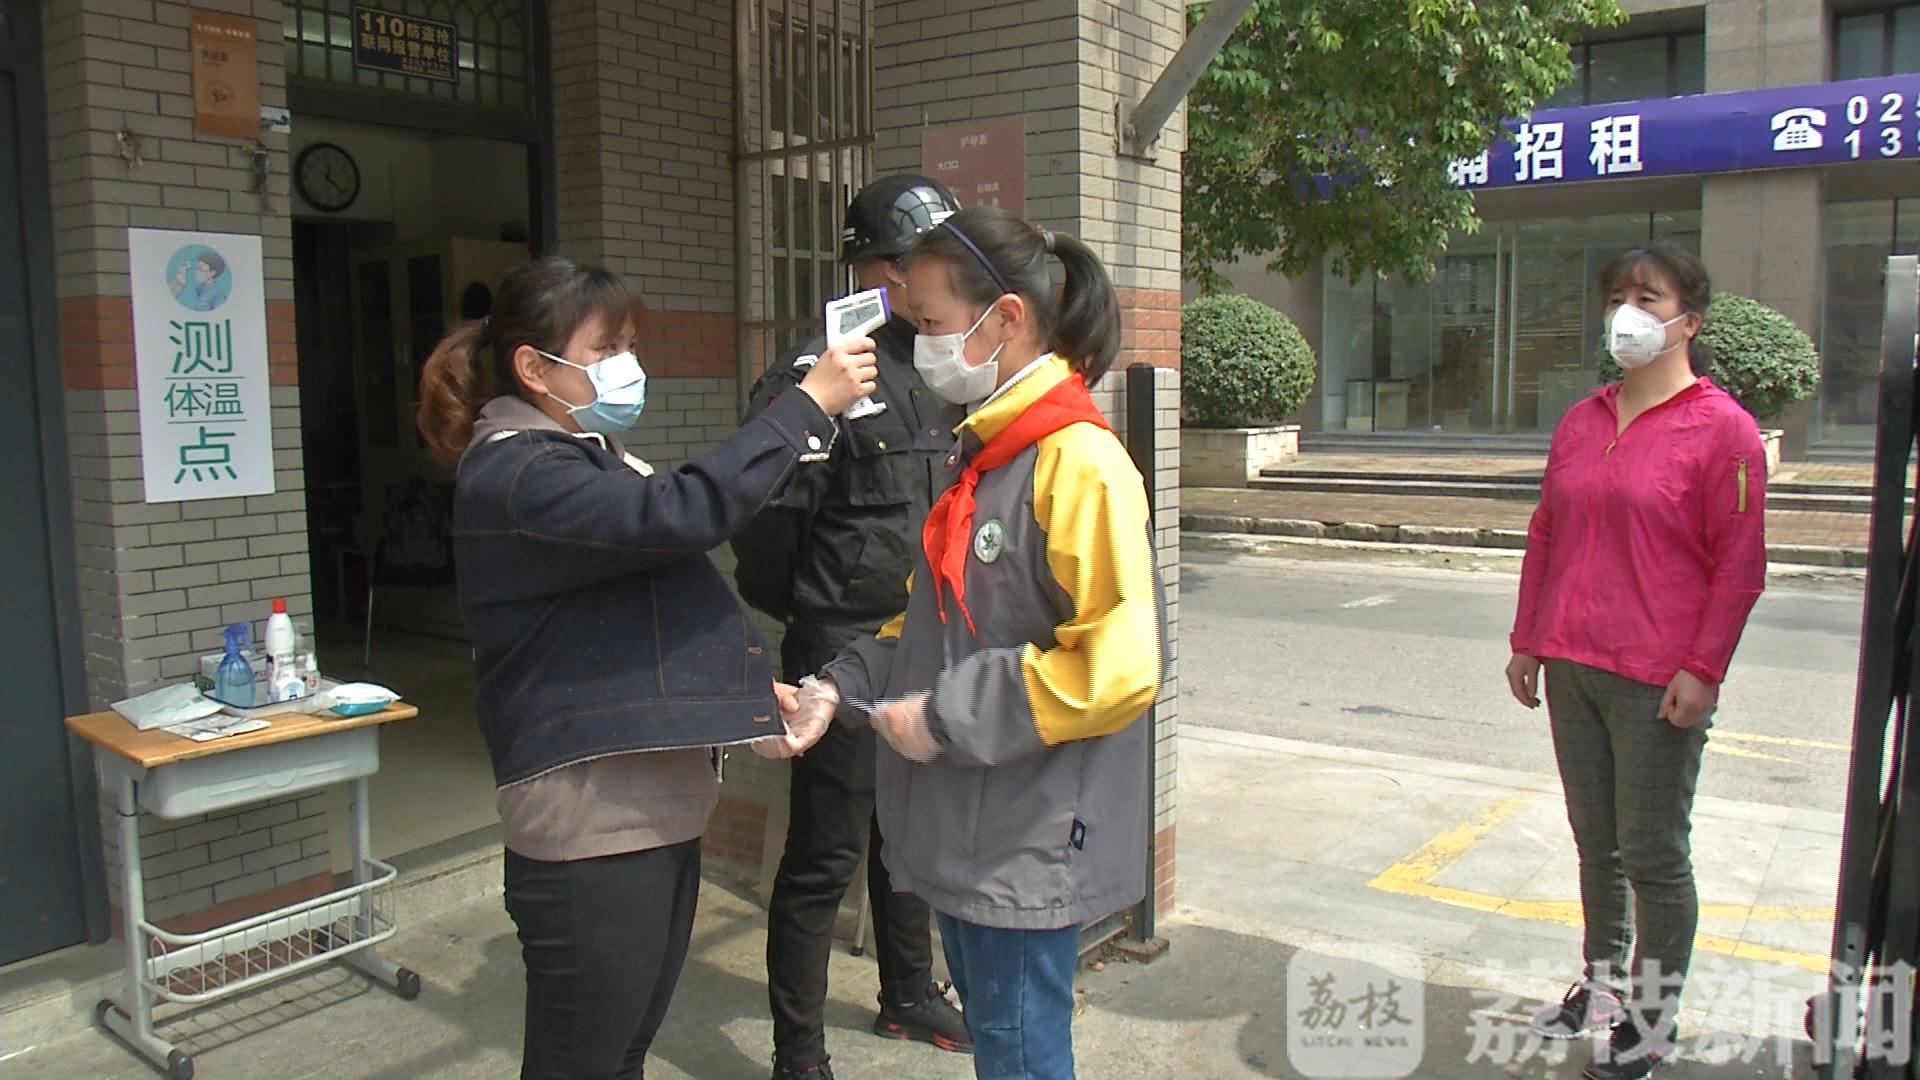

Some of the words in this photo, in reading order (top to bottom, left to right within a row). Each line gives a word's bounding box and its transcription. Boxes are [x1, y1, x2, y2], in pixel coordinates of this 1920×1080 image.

[1847, 92, 1920, 125] 02
[1844, 127, 1920, 158] 13
[169, 319, 232, 374] 测
[164, 382, 243, 417] 体温
[174, 426, 237, 484] 点
